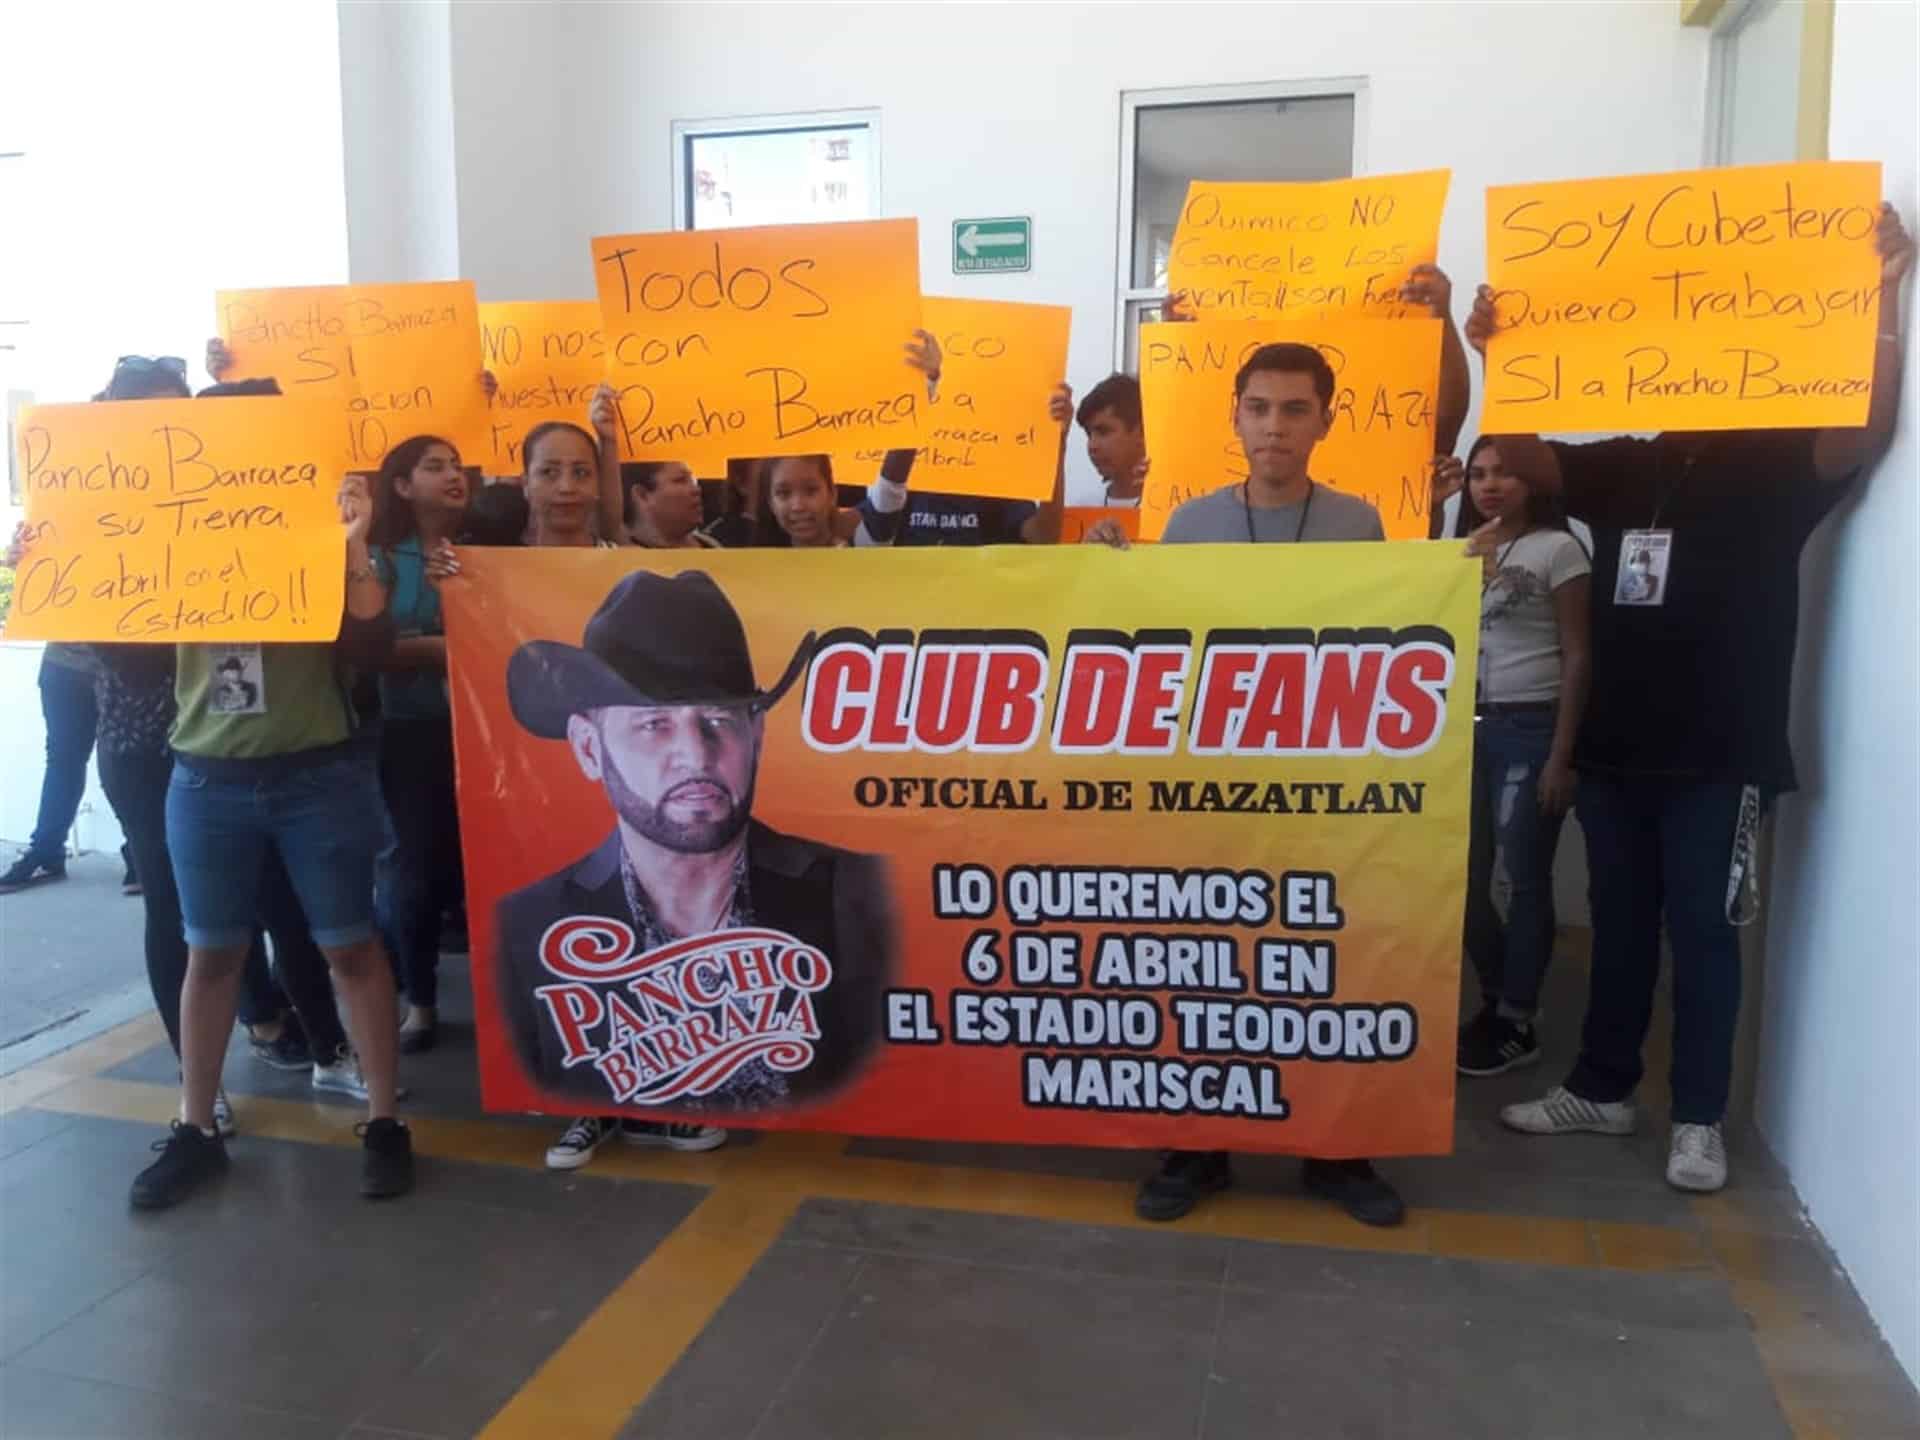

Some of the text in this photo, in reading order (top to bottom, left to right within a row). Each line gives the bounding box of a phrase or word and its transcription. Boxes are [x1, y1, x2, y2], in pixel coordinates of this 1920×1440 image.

[1350, 197, 1395, 228] NO
[1492, 289, 1637, 332] Quiero
[1624, 346, 1729, 405] Pancho
[611, 367, 918, 457] Pancho Barraza
[24, 424, 318, 496] Pancho Barraza
[90, 543, 172, 600] abril
[801, 625, 1456, 758] CLUB DE FANS
[853, 776, 1427, 815] OFICIAL DE MAZATLAN
[935, 866, 1342, 927] LO QUEREMOS EL
[964, 932, 1334, 996] 6 DE ABRIL EN
[535, 943, 832, 1069] PANCHO
[884, 989, 1417, 1059] EL ESTADIO TEODORO
[596, 988, 822, 1103] BARRAZA
[1024, 1055, 1288, 1118] MARISCAL
